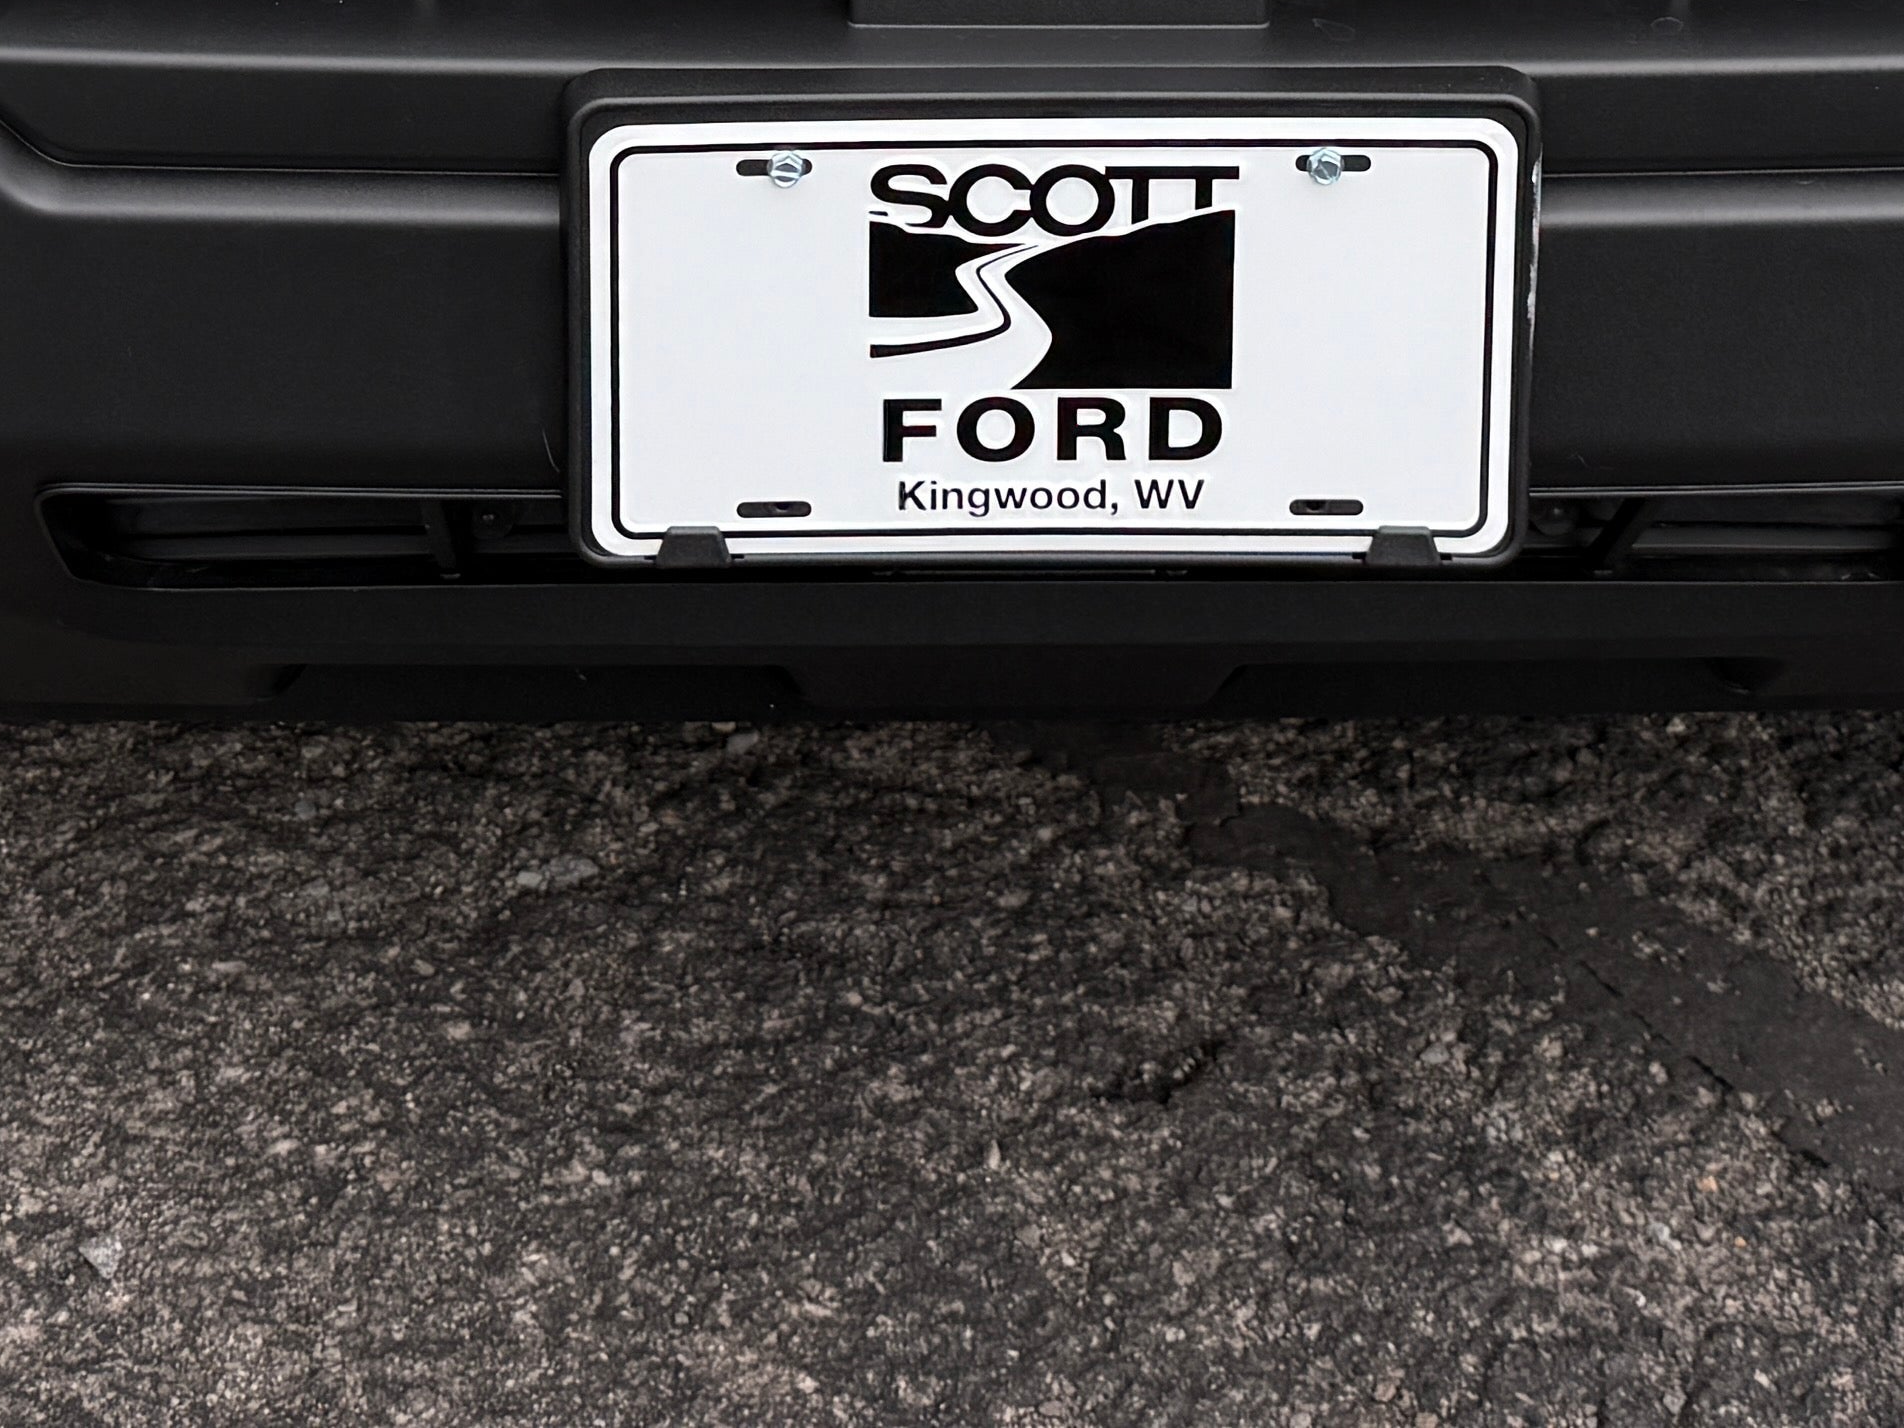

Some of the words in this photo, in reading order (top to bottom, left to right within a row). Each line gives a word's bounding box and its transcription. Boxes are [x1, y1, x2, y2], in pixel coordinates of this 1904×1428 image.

[869, 163, 1240, 238] SCOTT
[882, 396, 1223, 463] FORD
[898, 479, 1118, 518] Kingwood,
[1134, 479, 1205, 510] WV
